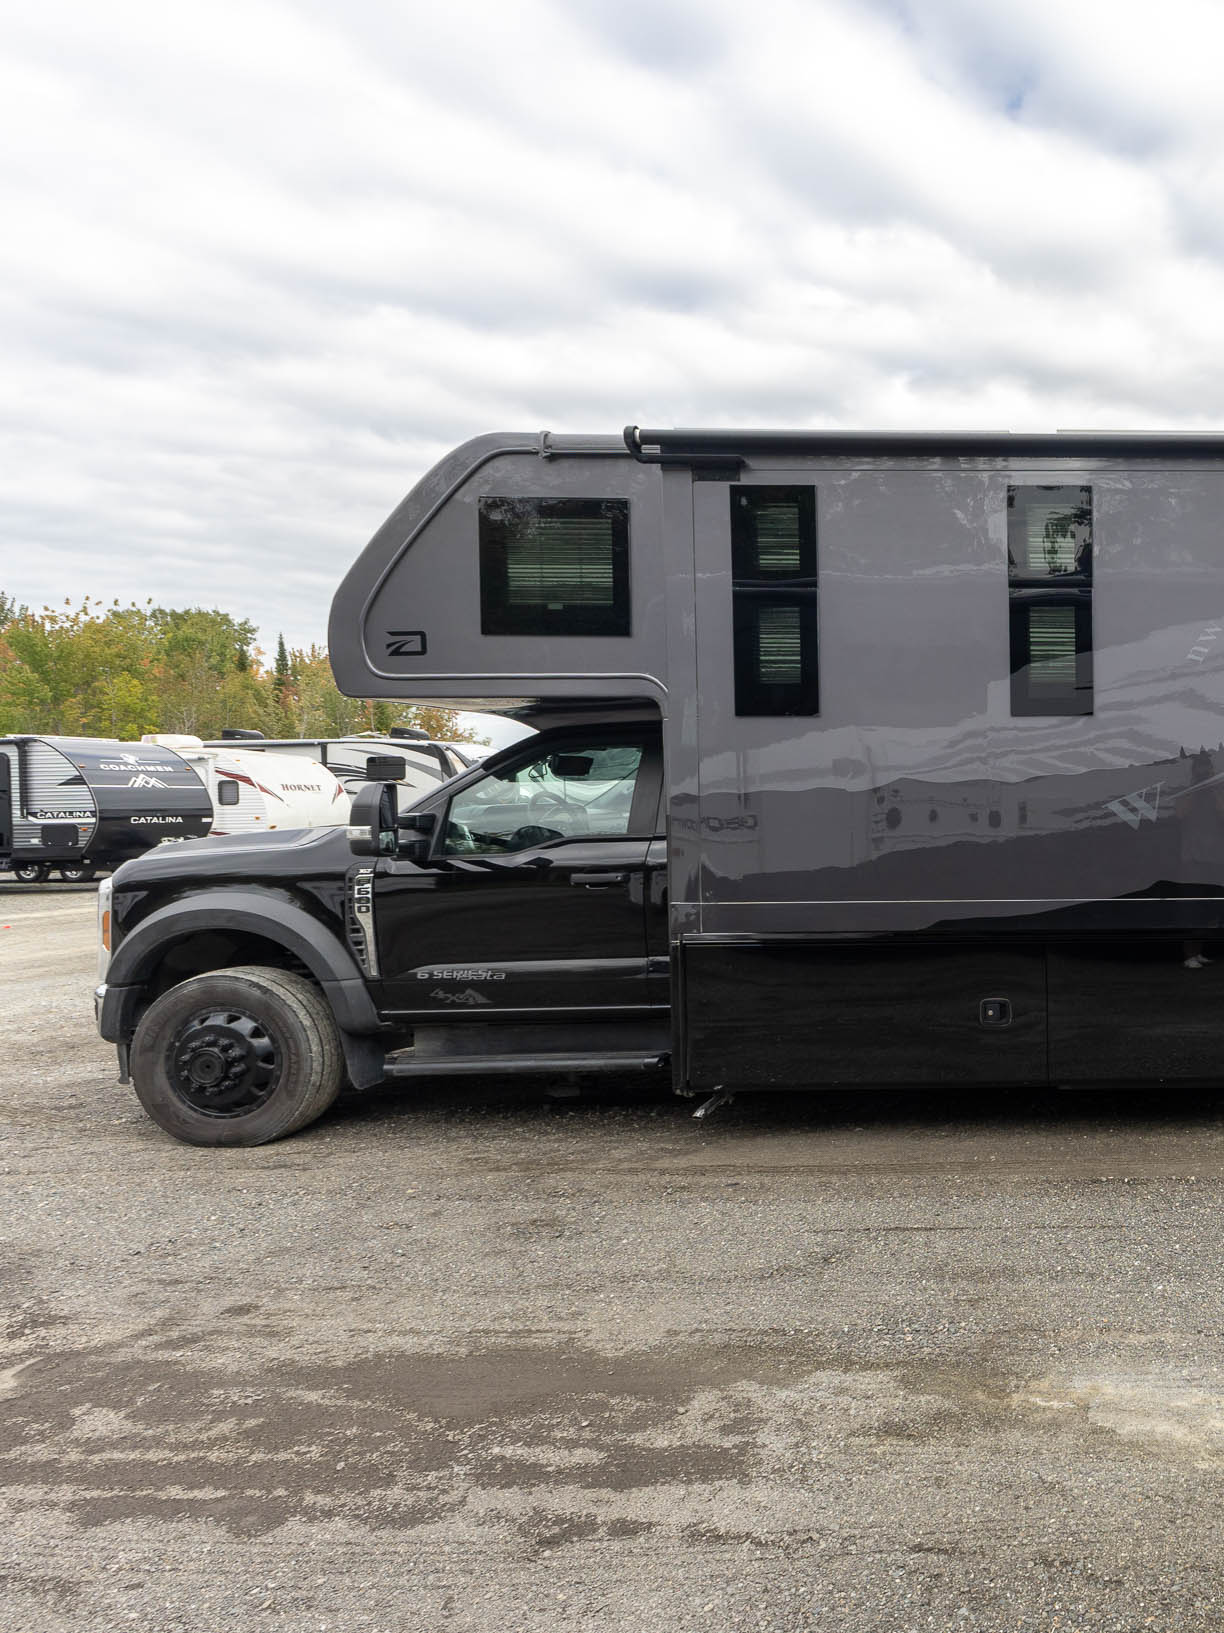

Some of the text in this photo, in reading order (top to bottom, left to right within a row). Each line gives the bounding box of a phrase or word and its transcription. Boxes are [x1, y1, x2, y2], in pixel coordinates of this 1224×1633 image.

[99, 763, 175, 772] COACHMEN
[1102, 779, 1167, 831] W
[36, 811, 93, 819] CATALINA
[130, 815, 184, 824] CATALINA
[417, 970, 430, 980] 6
